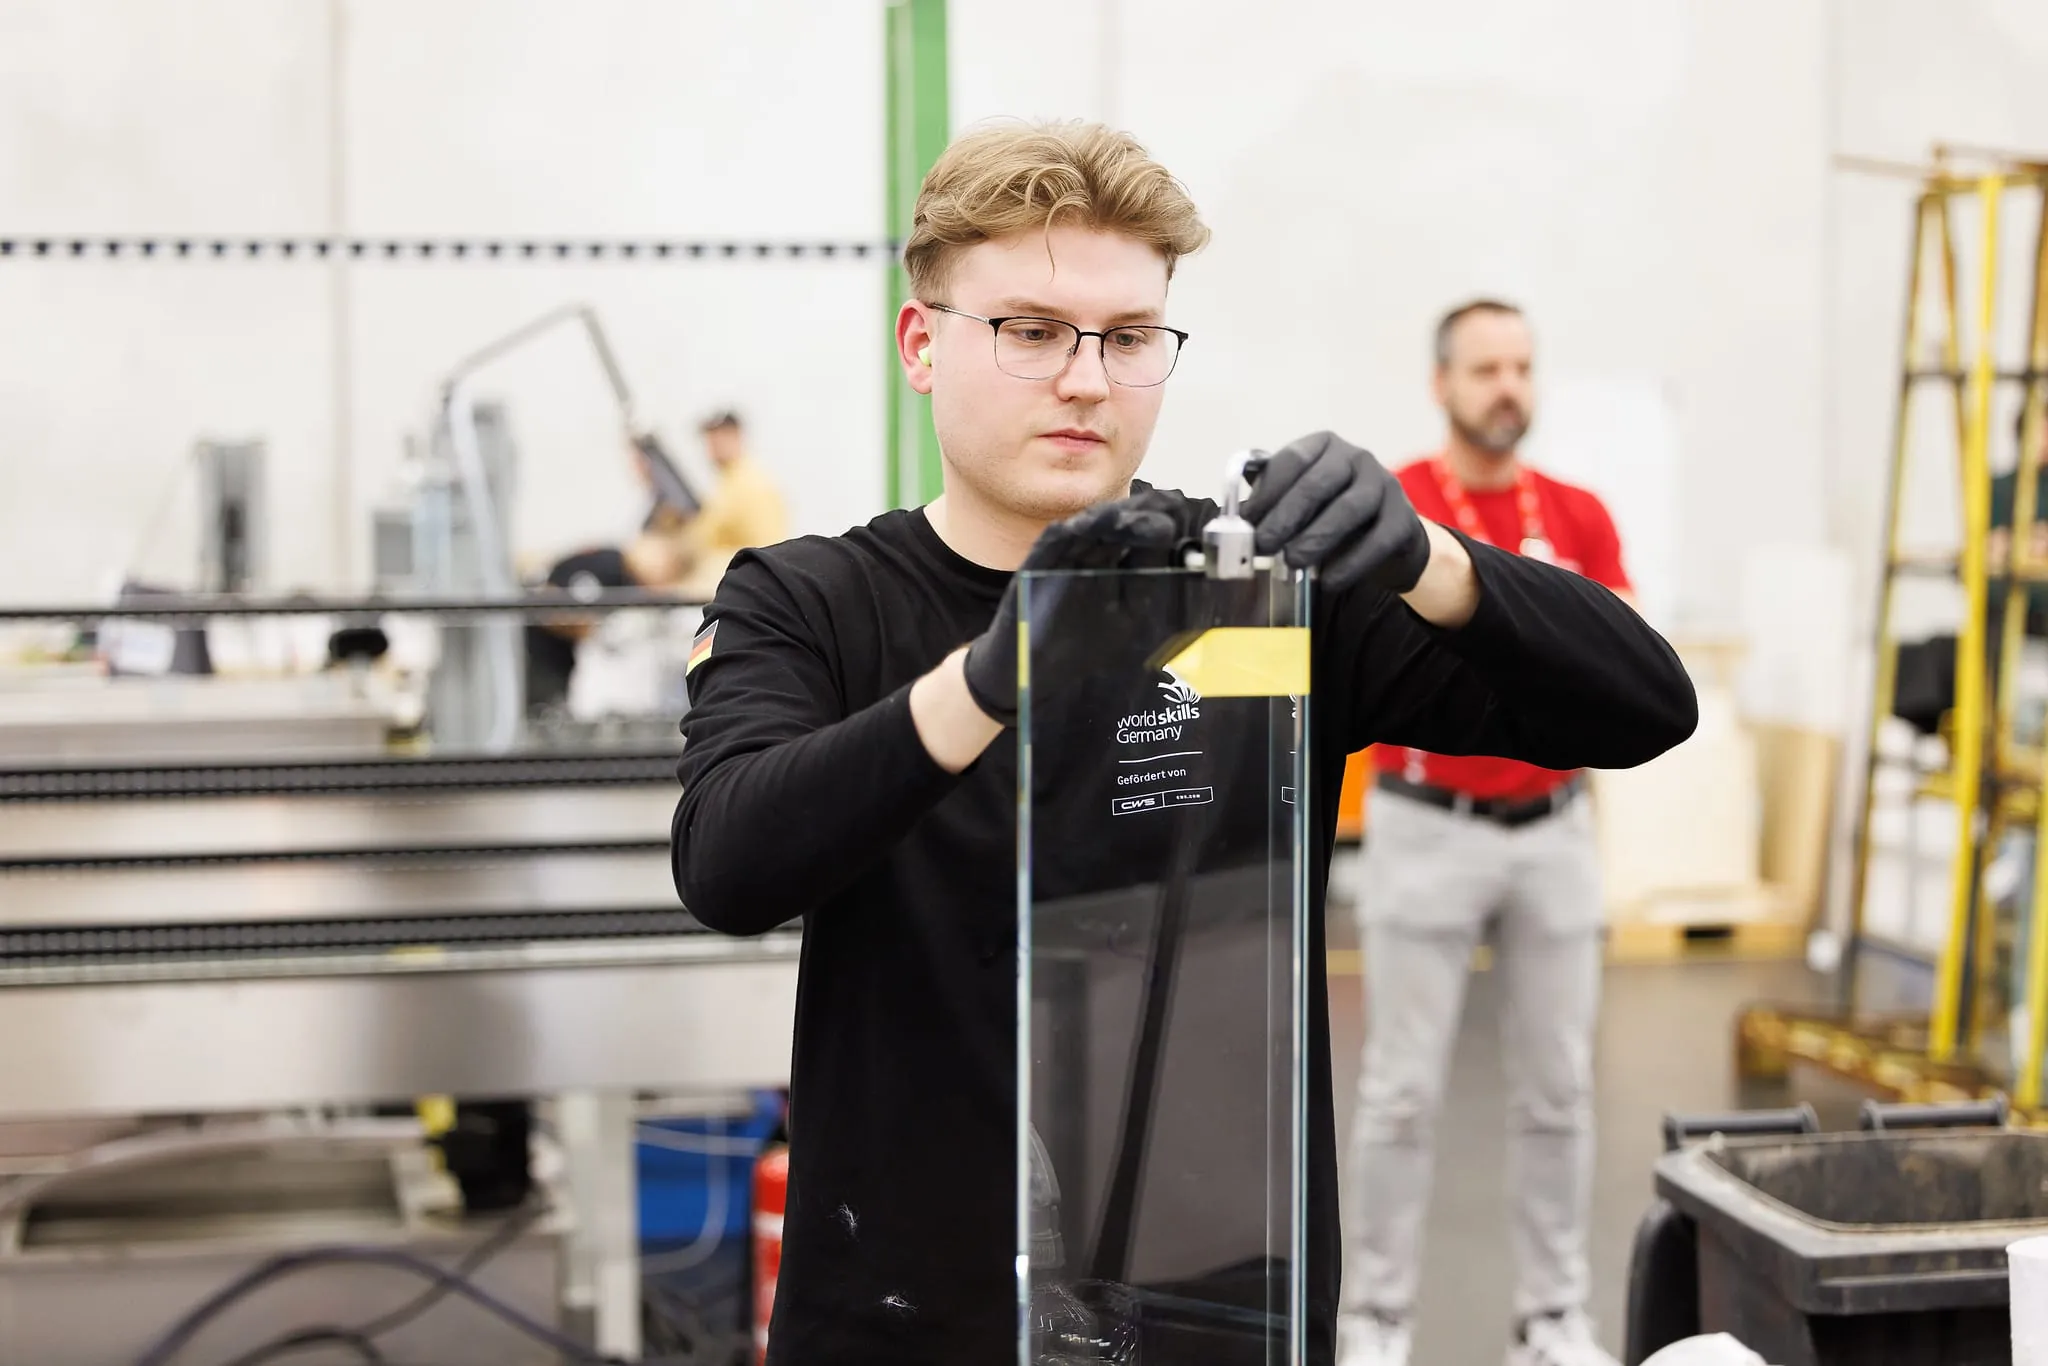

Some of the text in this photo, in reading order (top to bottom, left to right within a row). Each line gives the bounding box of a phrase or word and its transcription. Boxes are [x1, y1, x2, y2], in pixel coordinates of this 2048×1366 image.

[1116, 725, 1183, 744] Germany
[1117, 768, 1187, 785] Gefördert von
